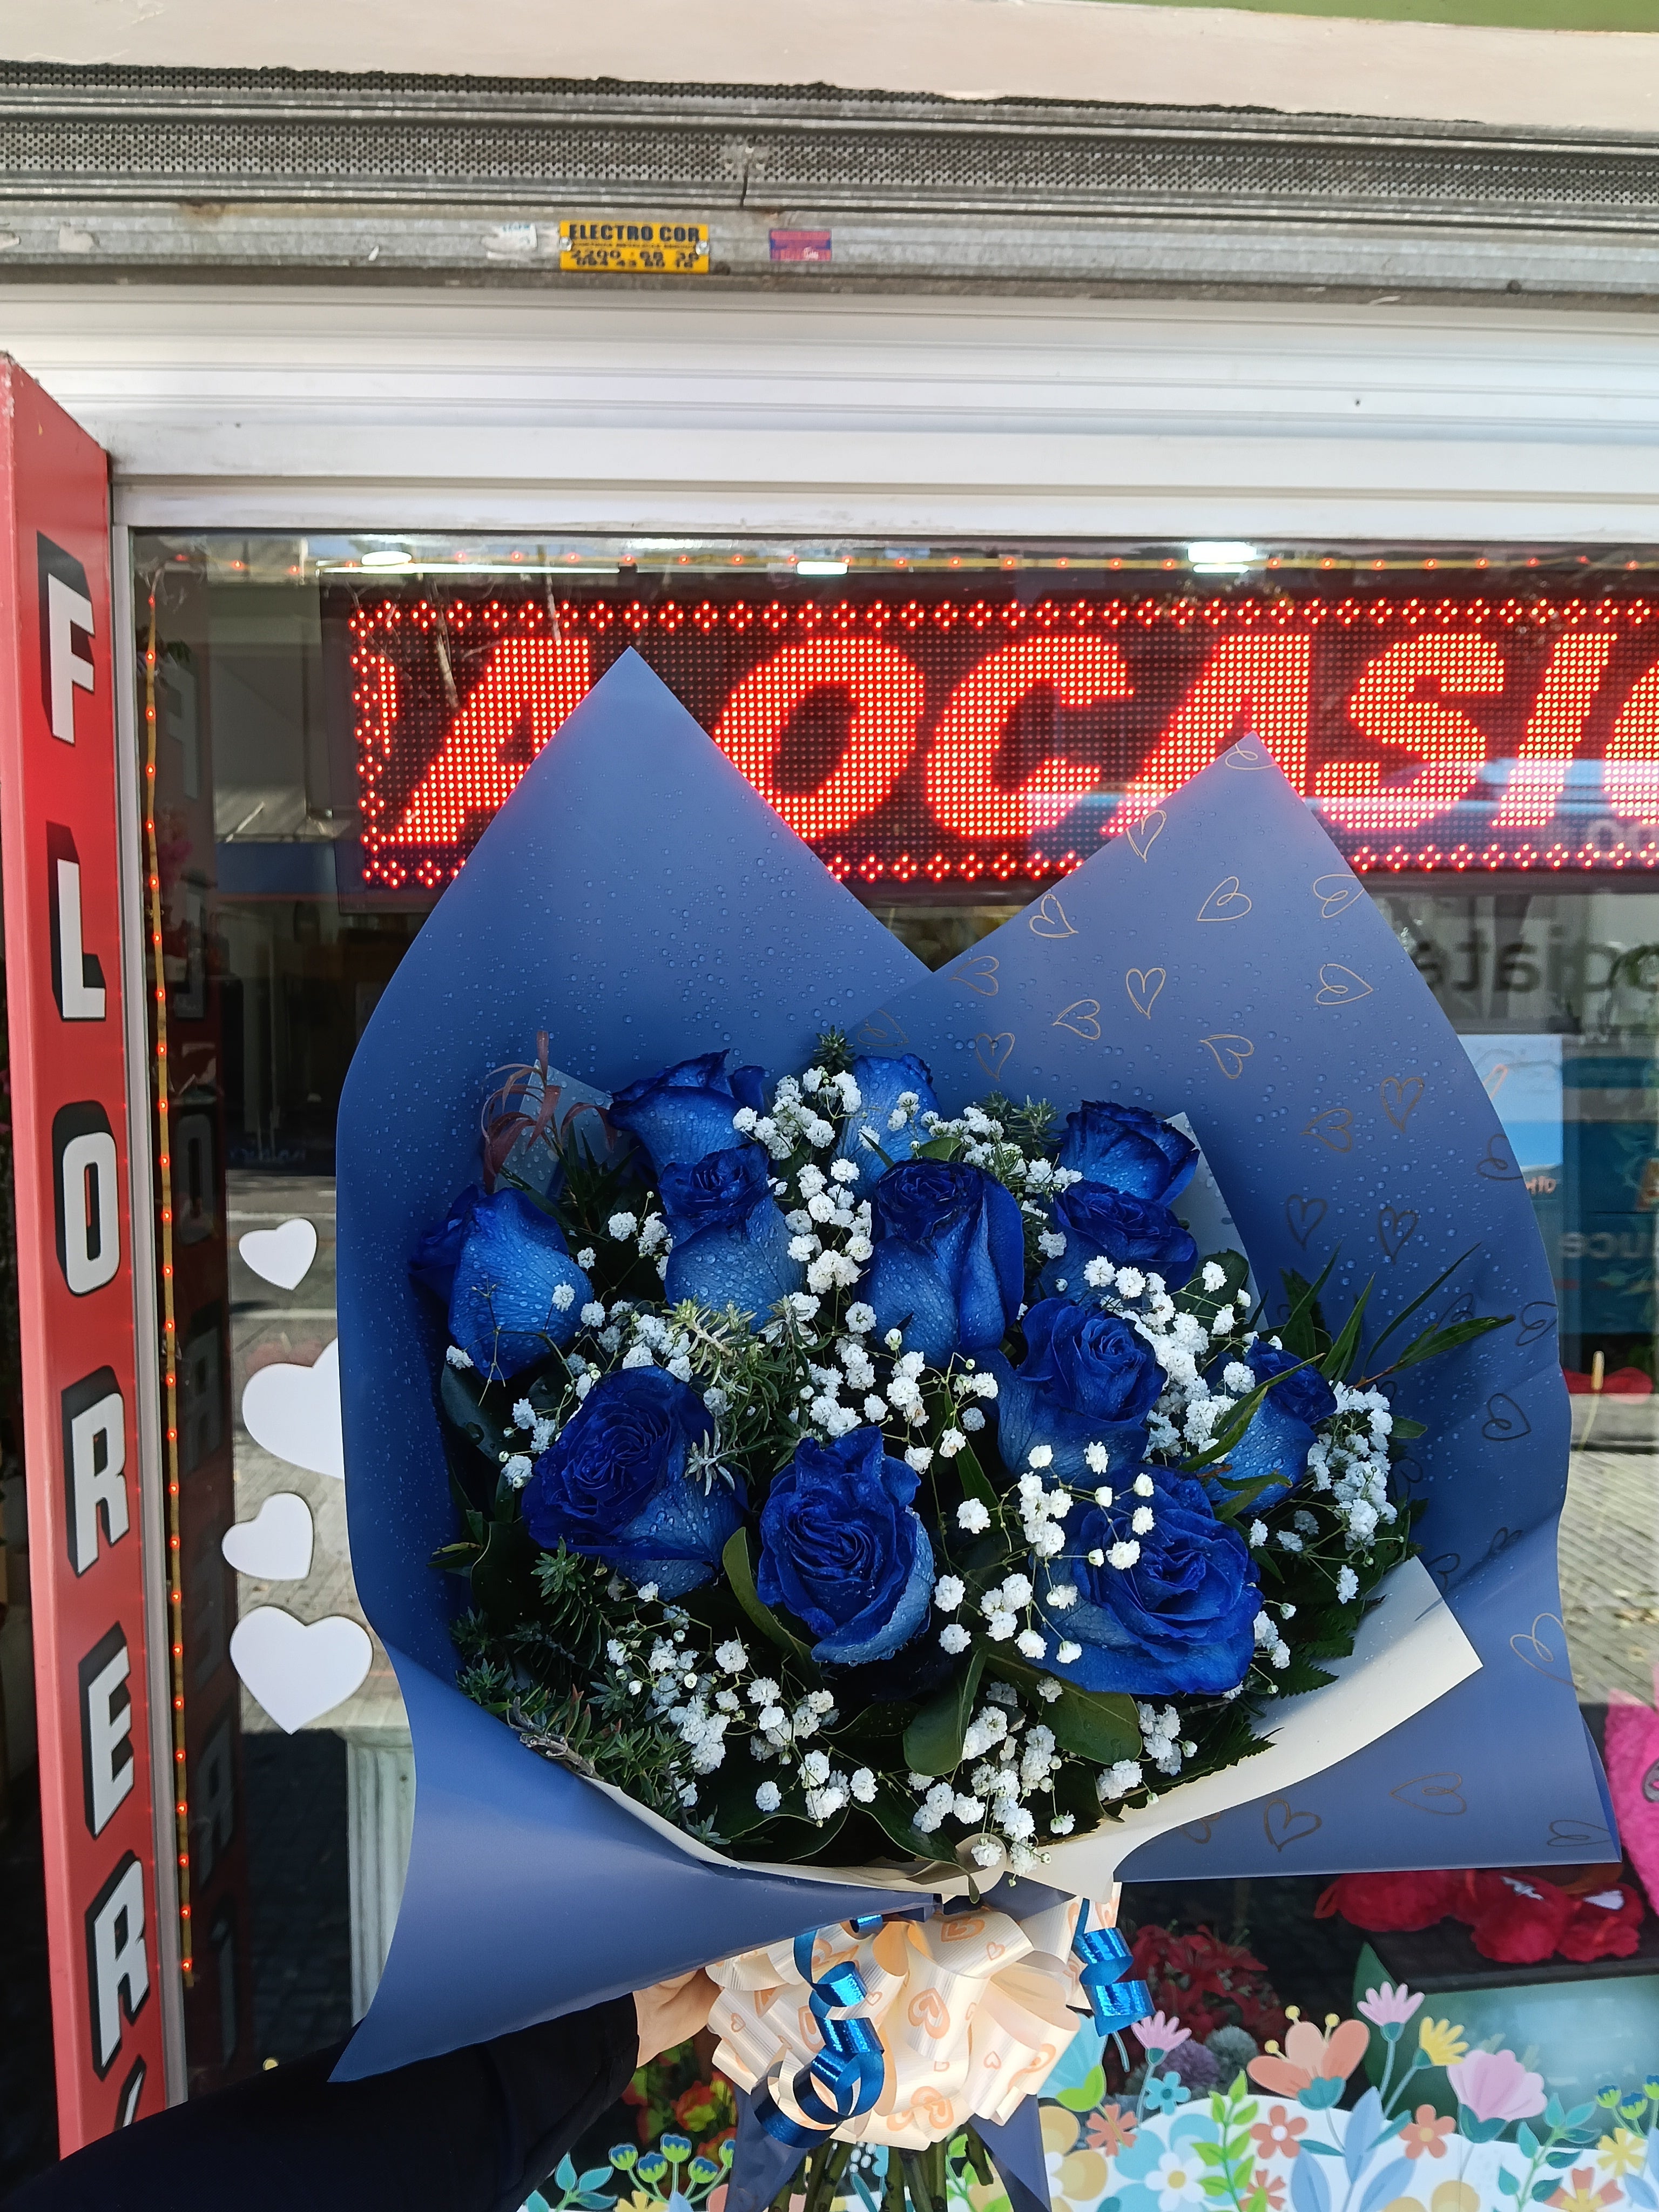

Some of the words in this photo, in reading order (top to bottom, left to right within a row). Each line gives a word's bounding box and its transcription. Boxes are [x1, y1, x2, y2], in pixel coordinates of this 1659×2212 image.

[569, 224, 653, 241] ELECTRO
[378, 637, 591, 845] A
[715, 633, 1659, 839] OCASI
